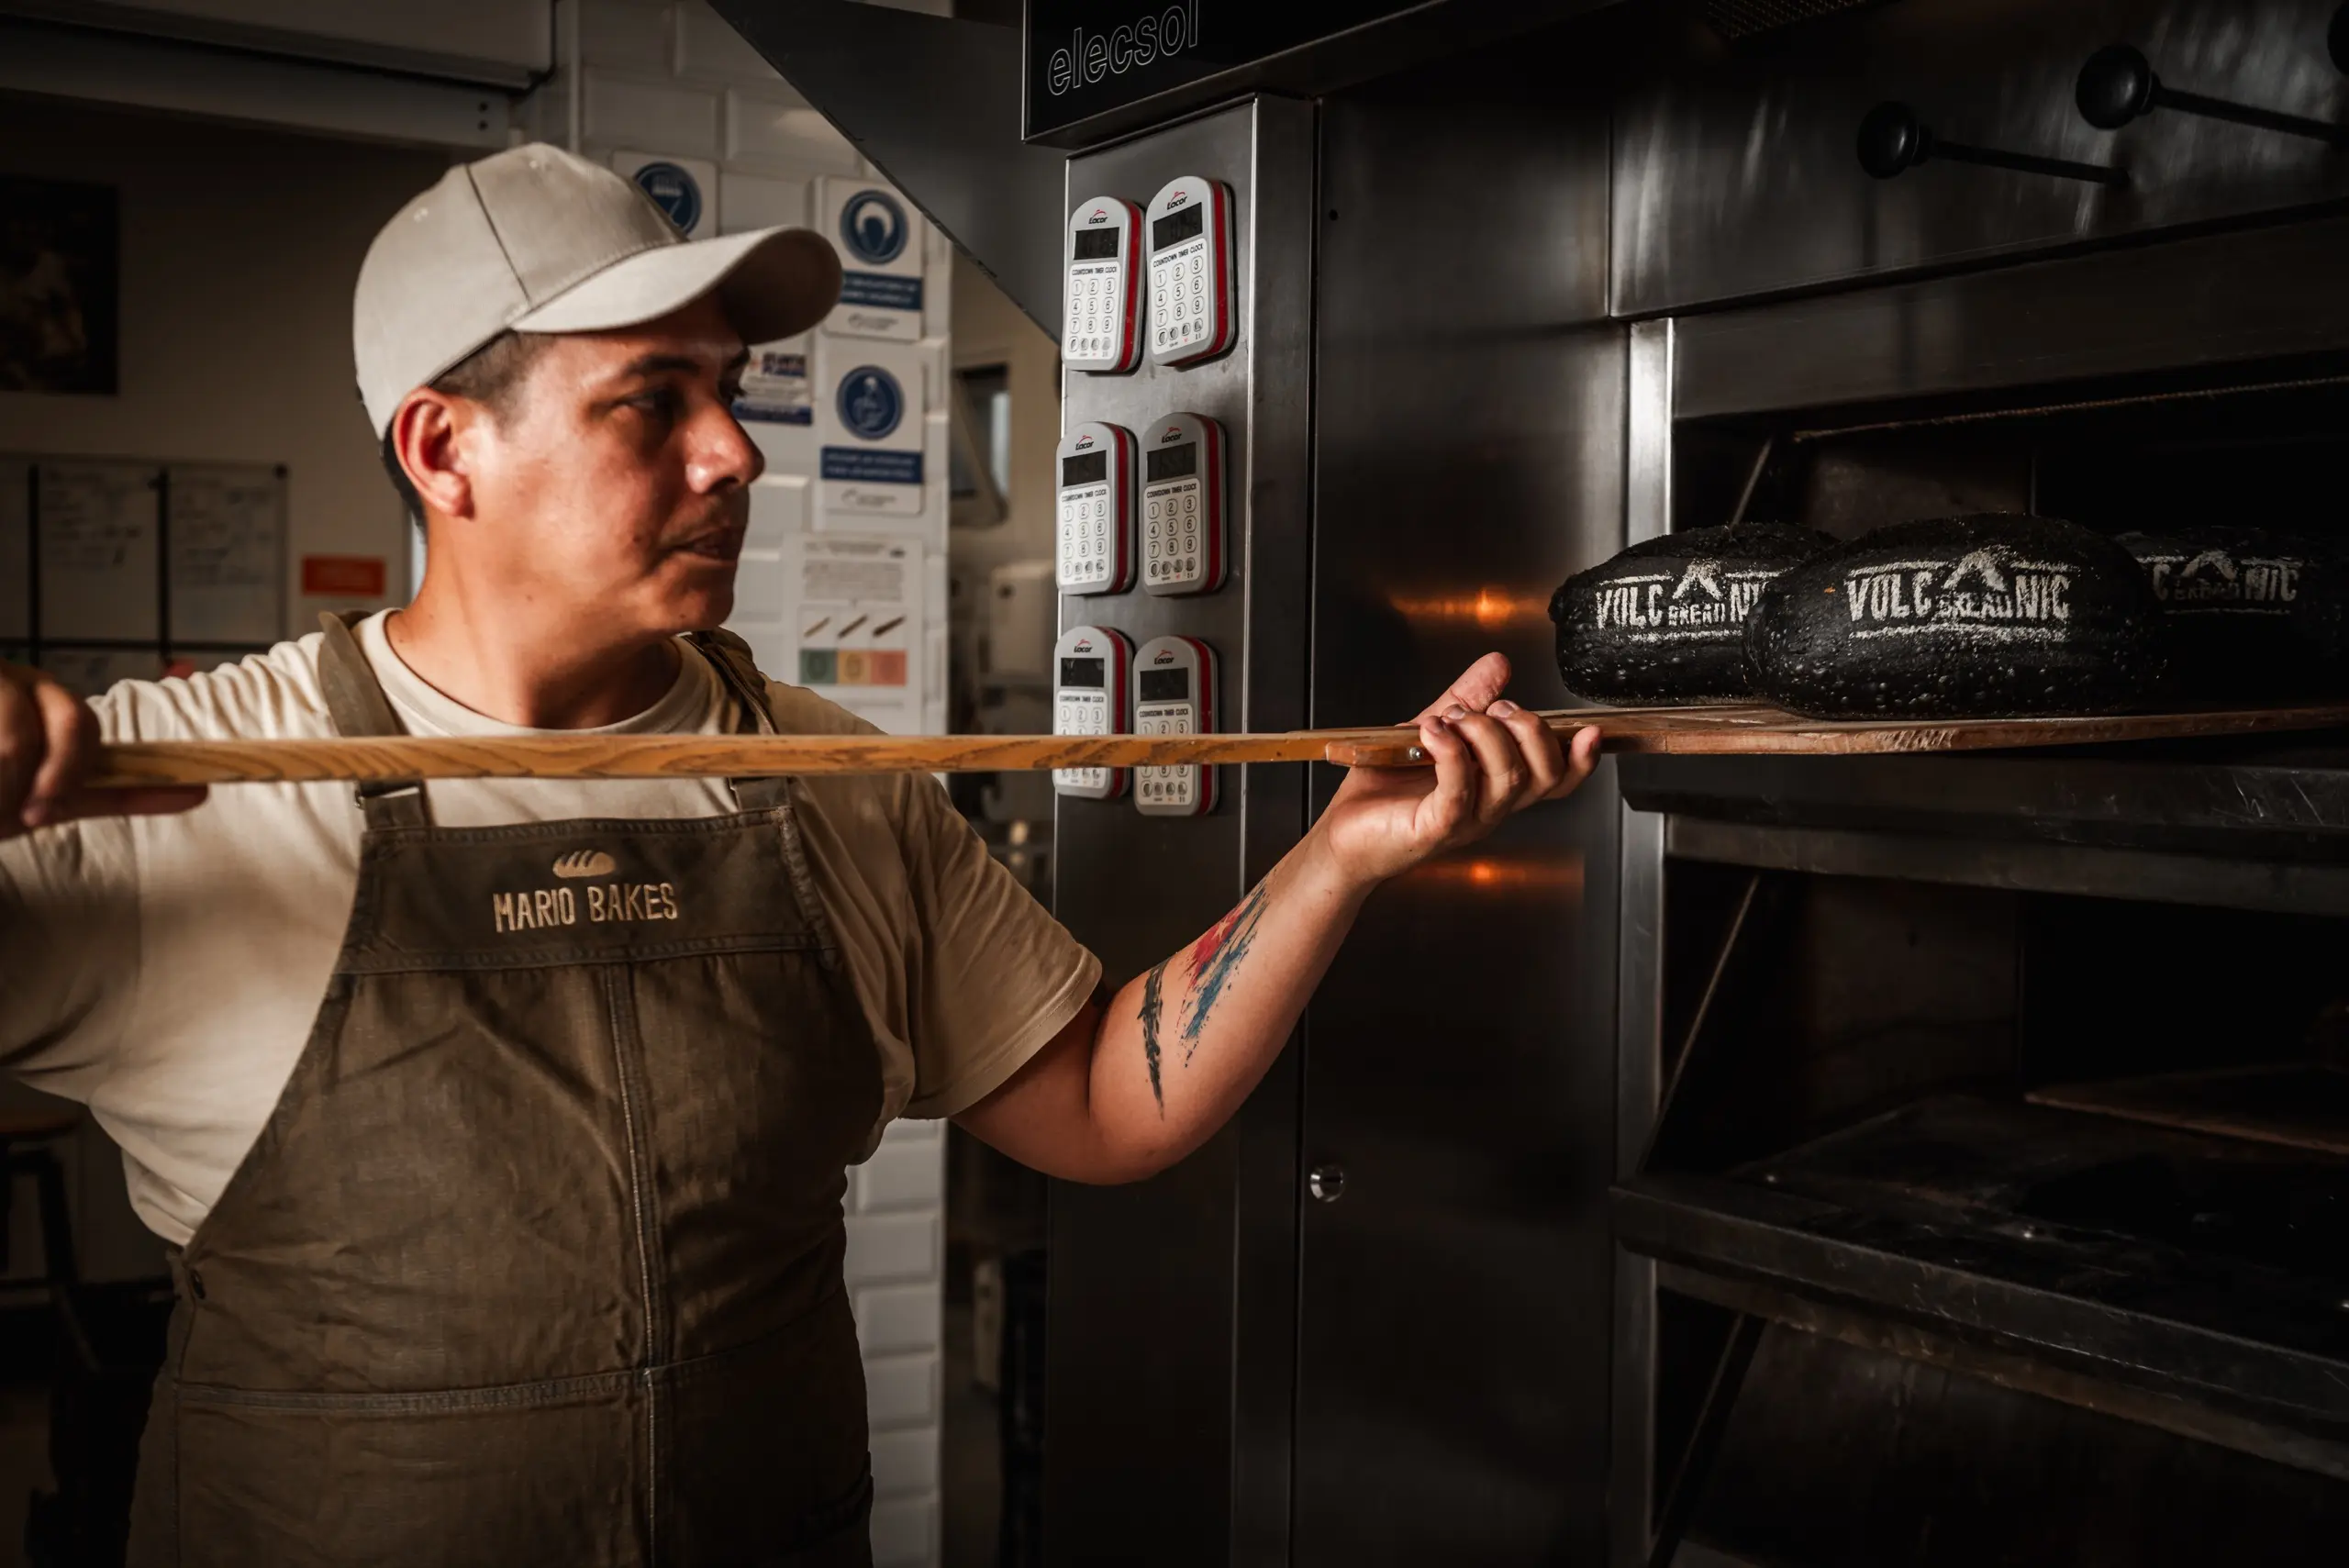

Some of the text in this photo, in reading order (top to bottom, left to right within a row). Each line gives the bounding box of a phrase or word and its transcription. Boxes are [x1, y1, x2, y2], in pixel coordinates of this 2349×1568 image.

[1048, 0, 1198, 95] elecsol
[1153, 243, 1203, 268] COUNTDOWN TIMER CLOCK
[493, 883, 678, 933] MARIO BAKES
